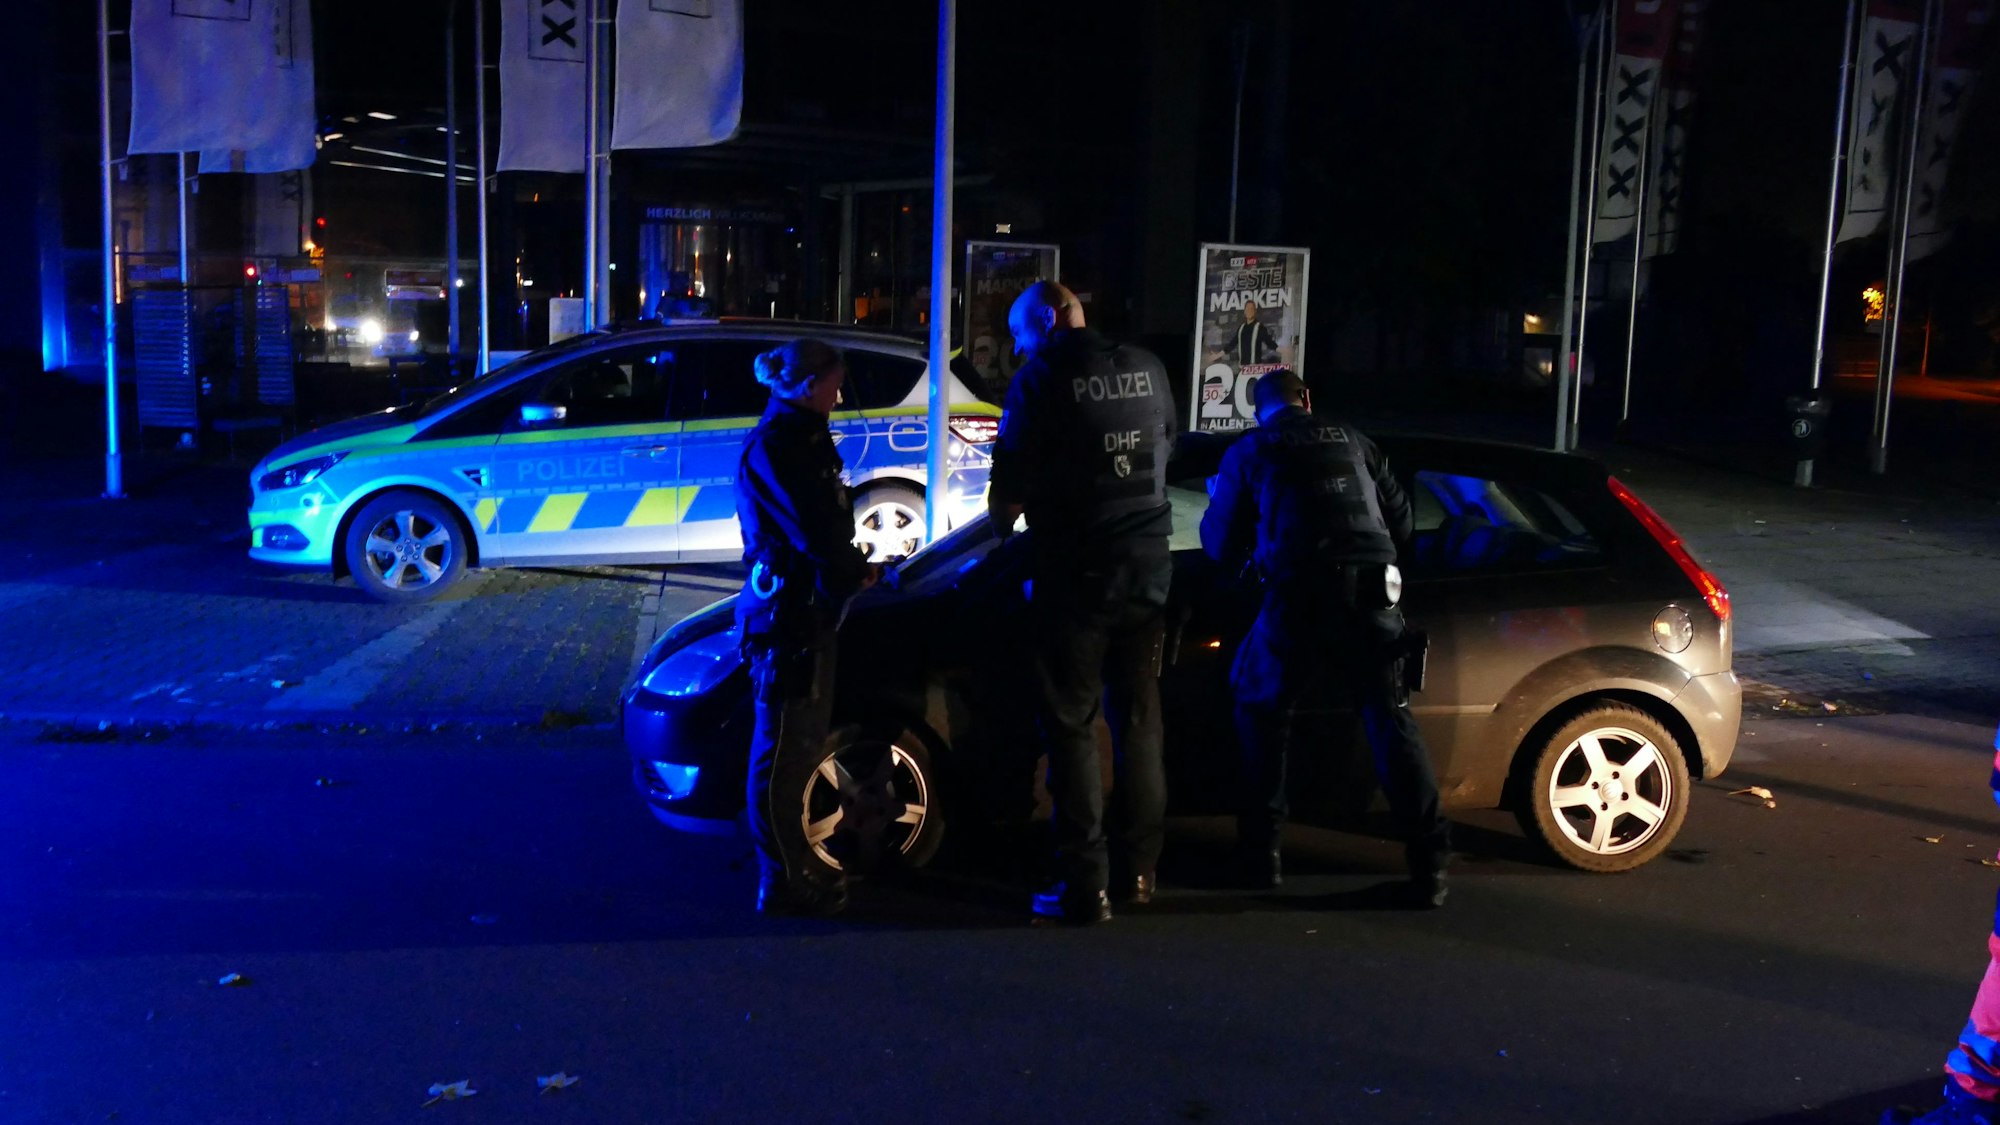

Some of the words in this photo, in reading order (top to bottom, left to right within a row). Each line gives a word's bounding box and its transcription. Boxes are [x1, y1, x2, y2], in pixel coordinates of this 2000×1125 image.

[646, 207, 711, 219] HERZLICH
[1221, 266, 1284, 292] BESTE
[1072, 371, 1154, 403] POLIZEI
[1209, 418, 1245, 431] ALLEN
[1104, 430, 1141, 453] DHF
[518, 456, 625, 483] POLIZEI
